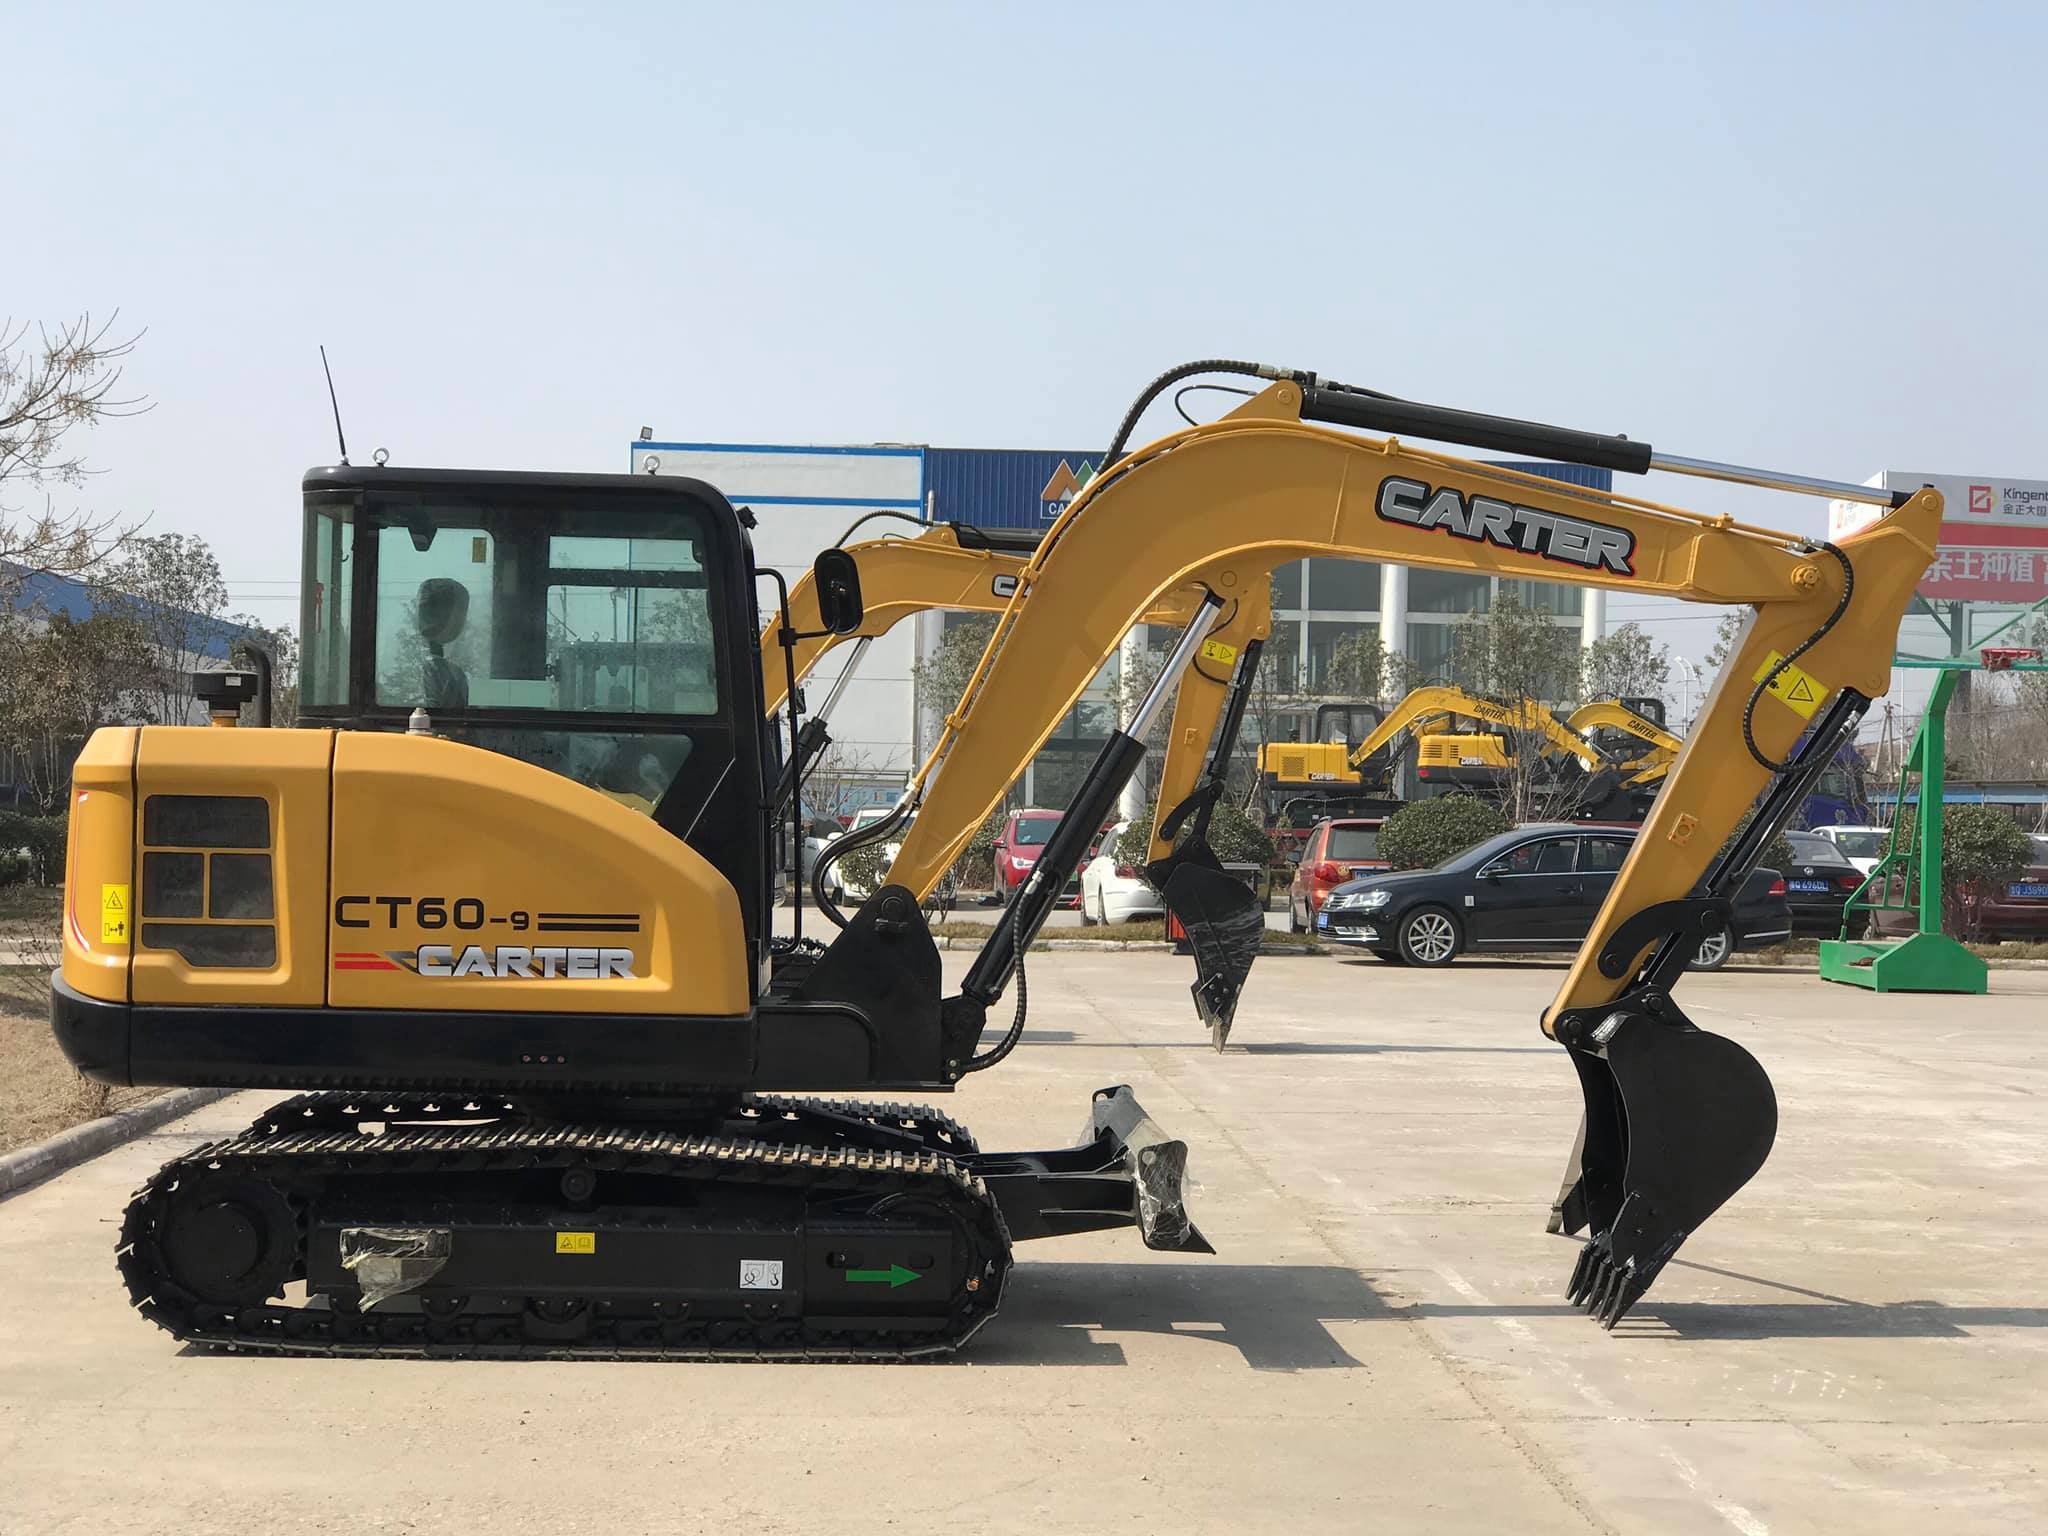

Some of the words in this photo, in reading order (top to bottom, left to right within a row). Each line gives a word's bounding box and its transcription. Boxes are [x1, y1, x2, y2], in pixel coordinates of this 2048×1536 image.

[1376, 476, 1636, 576] CARTER
[1627, 719, 1658, 740] CARTER
[335, 895, 530, 931] CT60-9
[416, 944, 638, 979] CARTER
